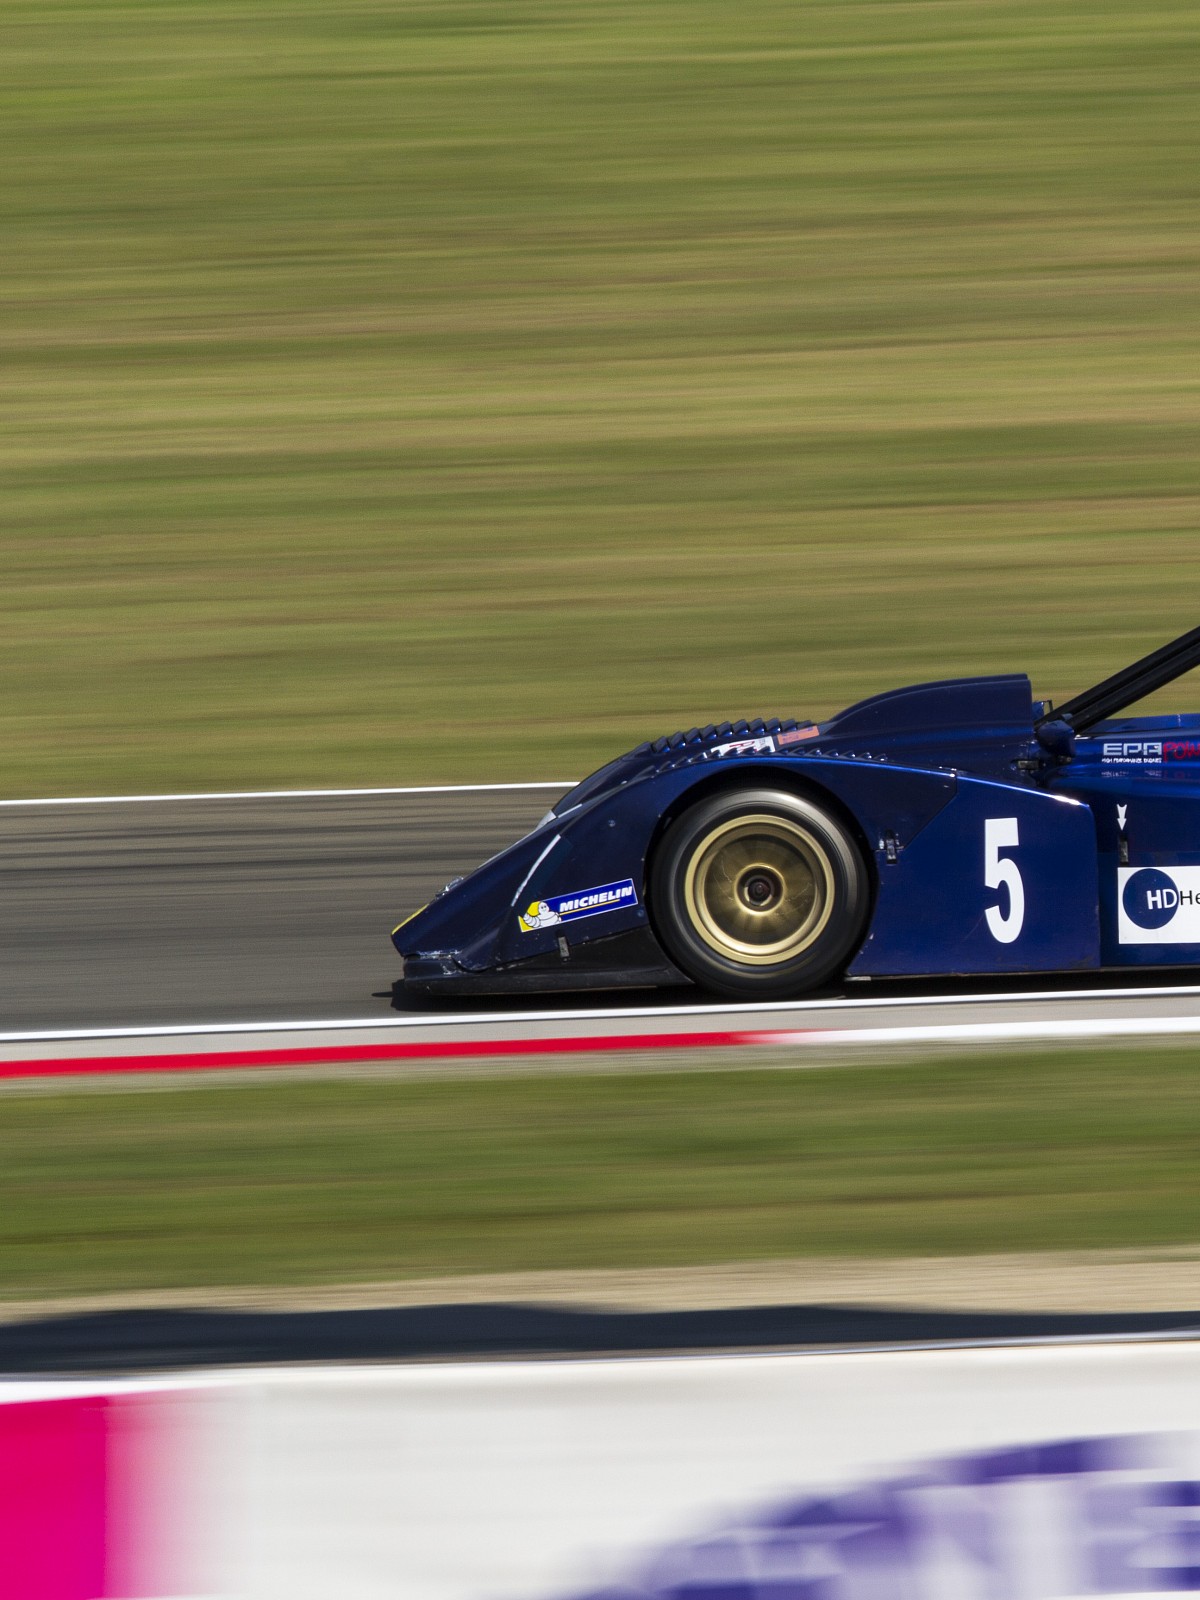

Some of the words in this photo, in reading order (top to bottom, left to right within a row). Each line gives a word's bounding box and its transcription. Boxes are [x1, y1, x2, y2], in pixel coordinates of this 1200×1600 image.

[1103, 742, 1162, 756] EPA
[984, 817, 1025, 944] 5
[559, 886, 633, 913] MICHELIN
[1146, 888, 1178, 910] HD
